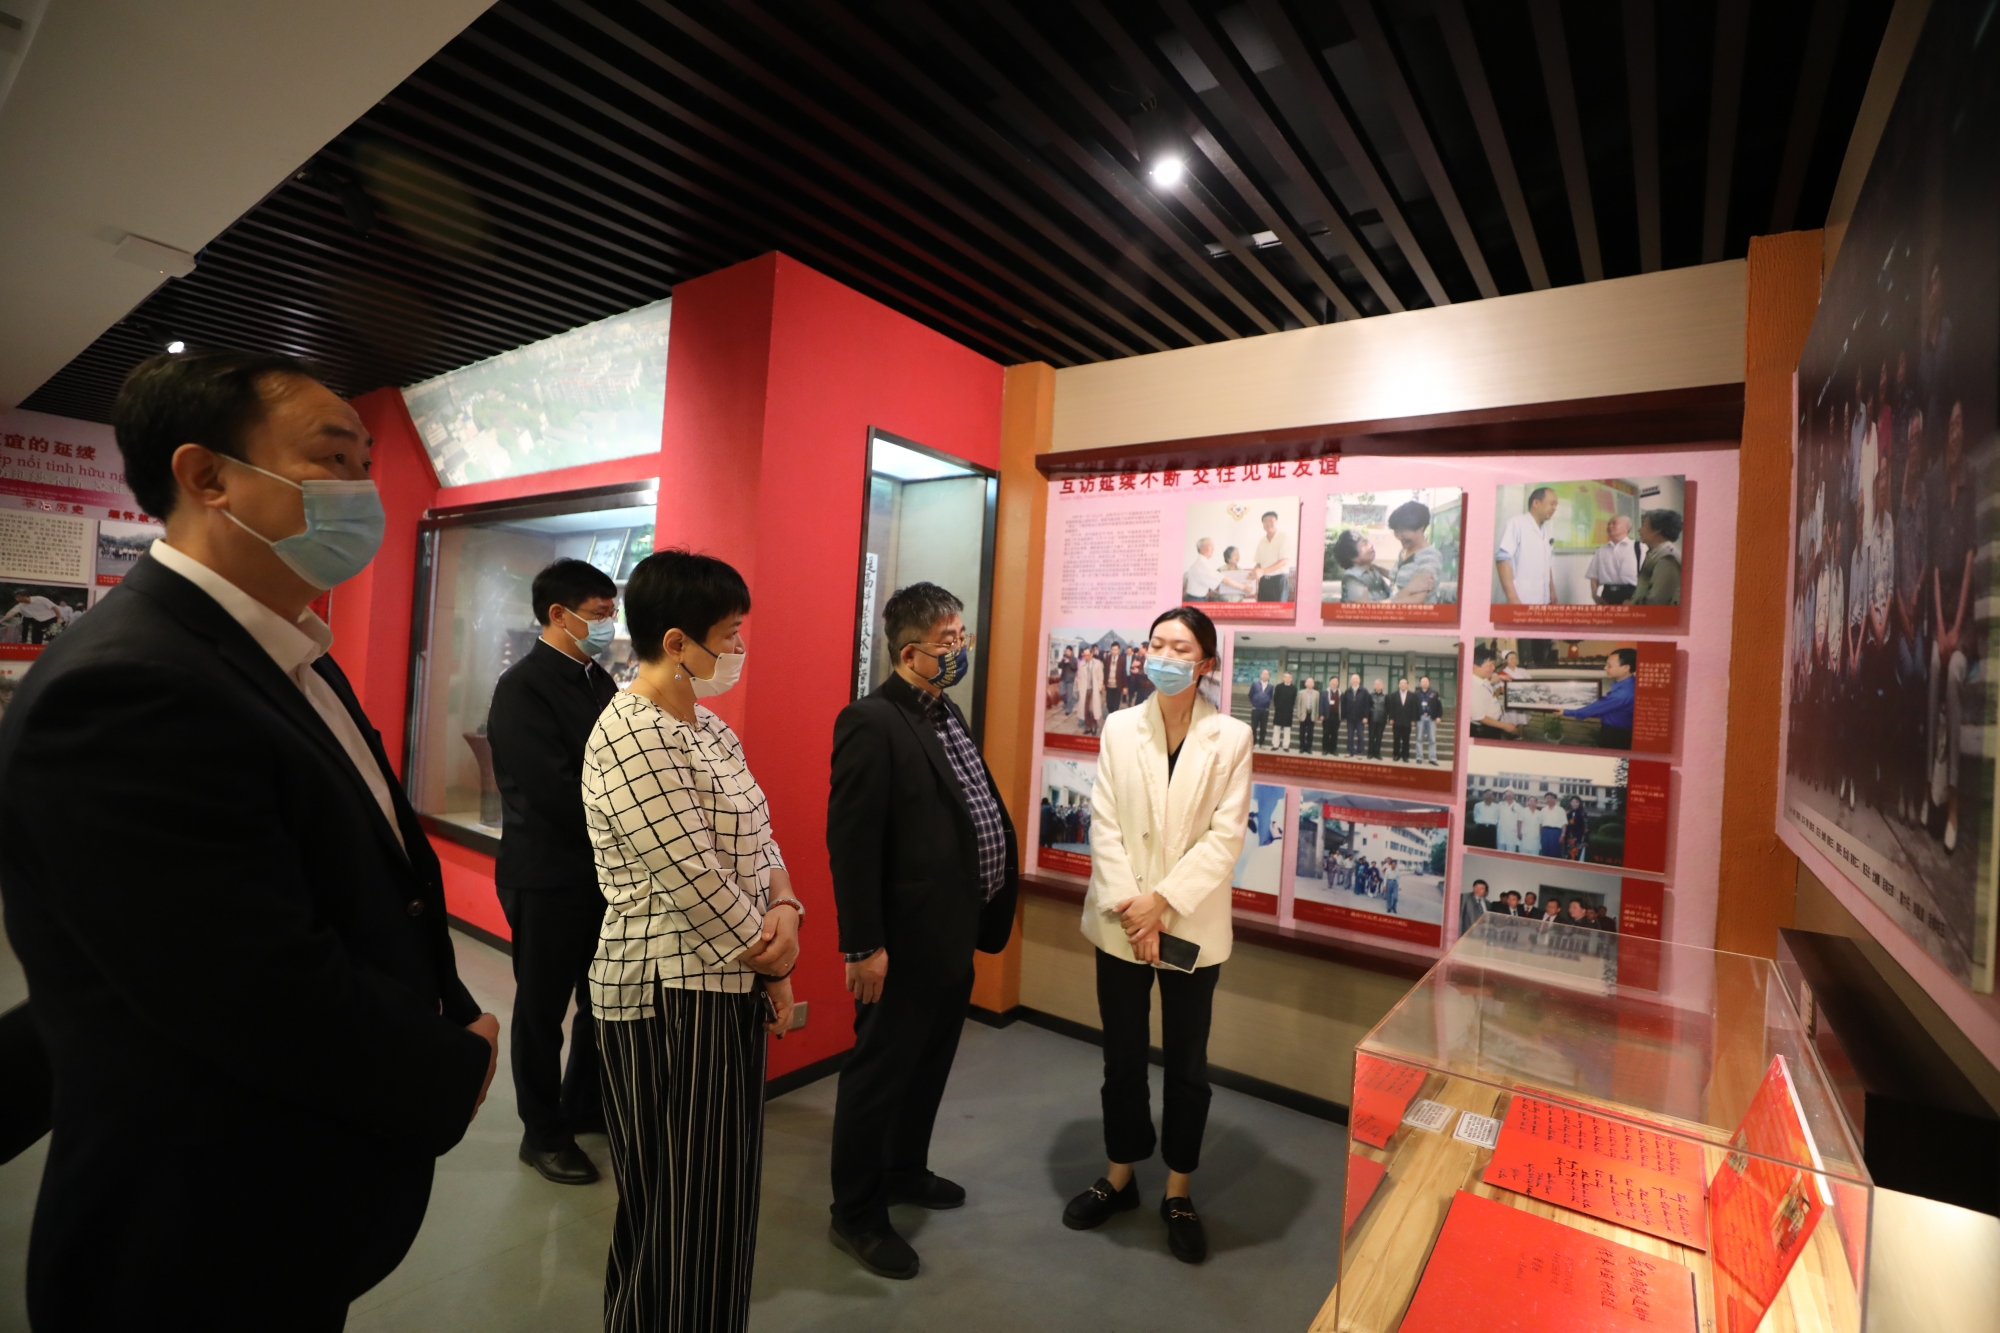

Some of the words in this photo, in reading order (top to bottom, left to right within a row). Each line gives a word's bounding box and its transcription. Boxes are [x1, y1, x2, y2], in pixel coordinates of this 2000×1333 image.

[0, 433, 97, 461] 谊的延续
[17, 454, 41, 470] nối
[46, 460, 74, 474] tình
[79, 464, 105, 479] hữu
[110, 471, 126, 484] ng
[1059, 469, 1182, 495] 互访延续不断
[1192, 454, 1340, 485] 交往见证友谊
[22, 498, 84, 516] 不忘历史
